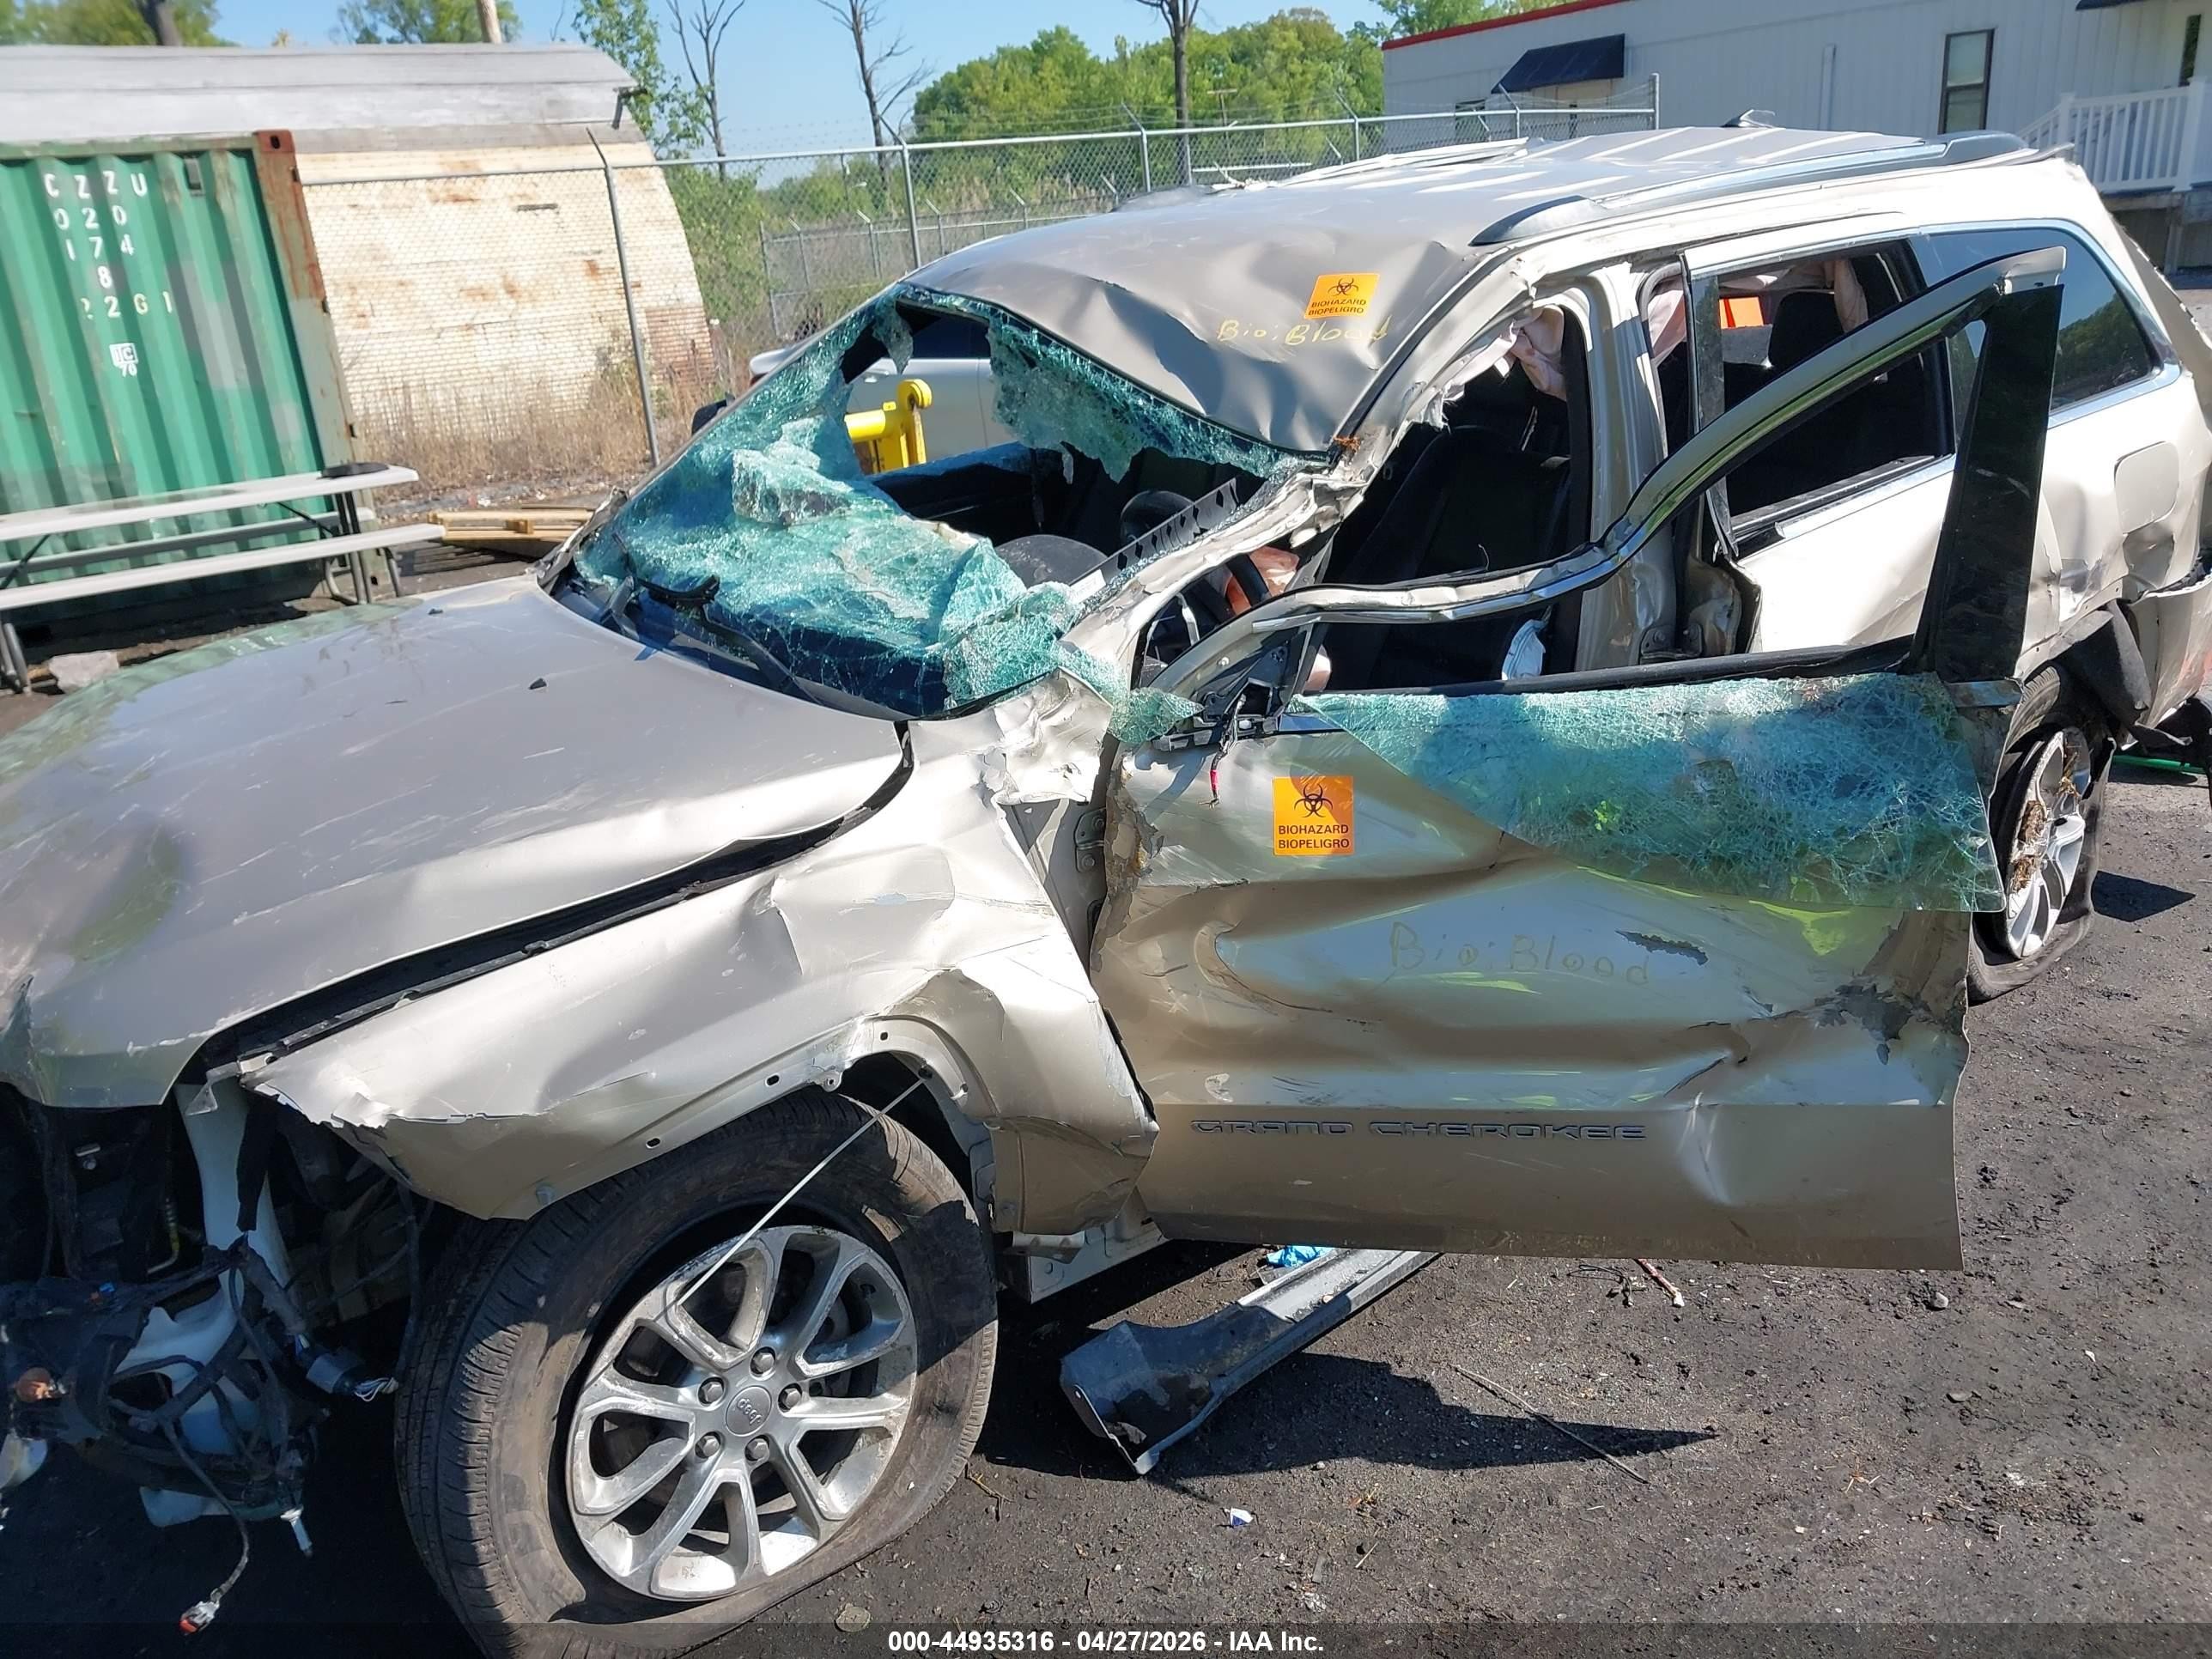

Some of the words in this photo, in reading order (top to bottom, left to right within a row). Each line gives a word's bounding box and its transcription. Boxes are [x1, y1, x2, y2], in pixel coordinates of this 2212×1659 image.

[53, 204, 127, 230] 020
[65, 234, 135, 260] 174
[97, 265, 112, 289] 8
[1311, 298, 1367, 307] BIOHAZARD
[1308, 307, 1364, 316] BIOPELIGRO
[1278, 824, 1349, 835] BIOHAZARD
[1278, 838, 1350, 848] BIOPELIGRO
[1191, 1119, 1353, 1135] GRAND
[1369, 1121, 1646, 1140] CHEROKEE
